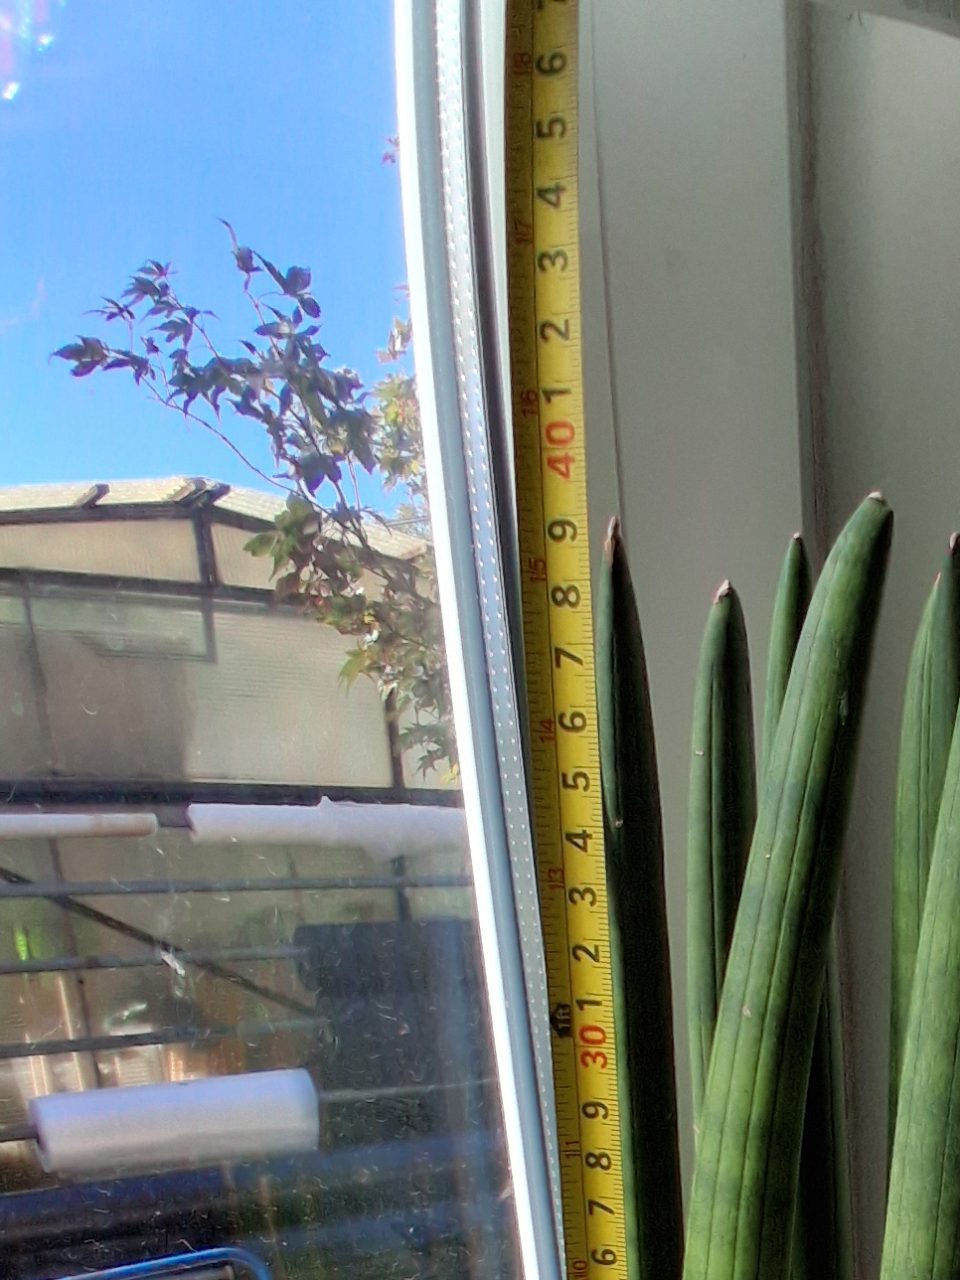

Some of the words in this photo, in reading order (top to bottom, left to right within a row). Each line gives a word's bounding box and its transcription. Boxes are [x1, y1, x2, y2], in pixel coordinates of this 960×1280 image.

[535, 52, 567, 76] 6
[535, 116, 567, 139] 5
[537, 182, 566, 209] 4
[537, 249, 568, 273] 3
[540, 319, 570, 343] 2
[520, 389, 539, 417] 16
[542, 387, 572, 403] 1
[545, 420, 575, 480] 40
[547, 519, 578, 543] 9
[529, 558, 546, 582] 15
[551, 585, 581, 608] 8
[554, 647, 583, 669] 7
[539, 719, 556, 743] 14
[558, 711, 587, 733] 6
[562, 770, 590, 792] 5
[566, 829, 592, 853] 4
[548, 868, 565, 889] 13
[569, 887, 597, 907] 3
[572, 944, 600, 963] 2
[576, 998, 602, 1011] 1
[579, 1025, 608, 1069] 30
[582, 1101, 608, 1120] 9
[565, 1140, 581, 1159] 11
[585, 1152, 612, 1171] 8
[588, 1200, 615, 1216] 7
[591, 1249, 617, 1266] 6
[573, 1260, 588, 1280] 10
